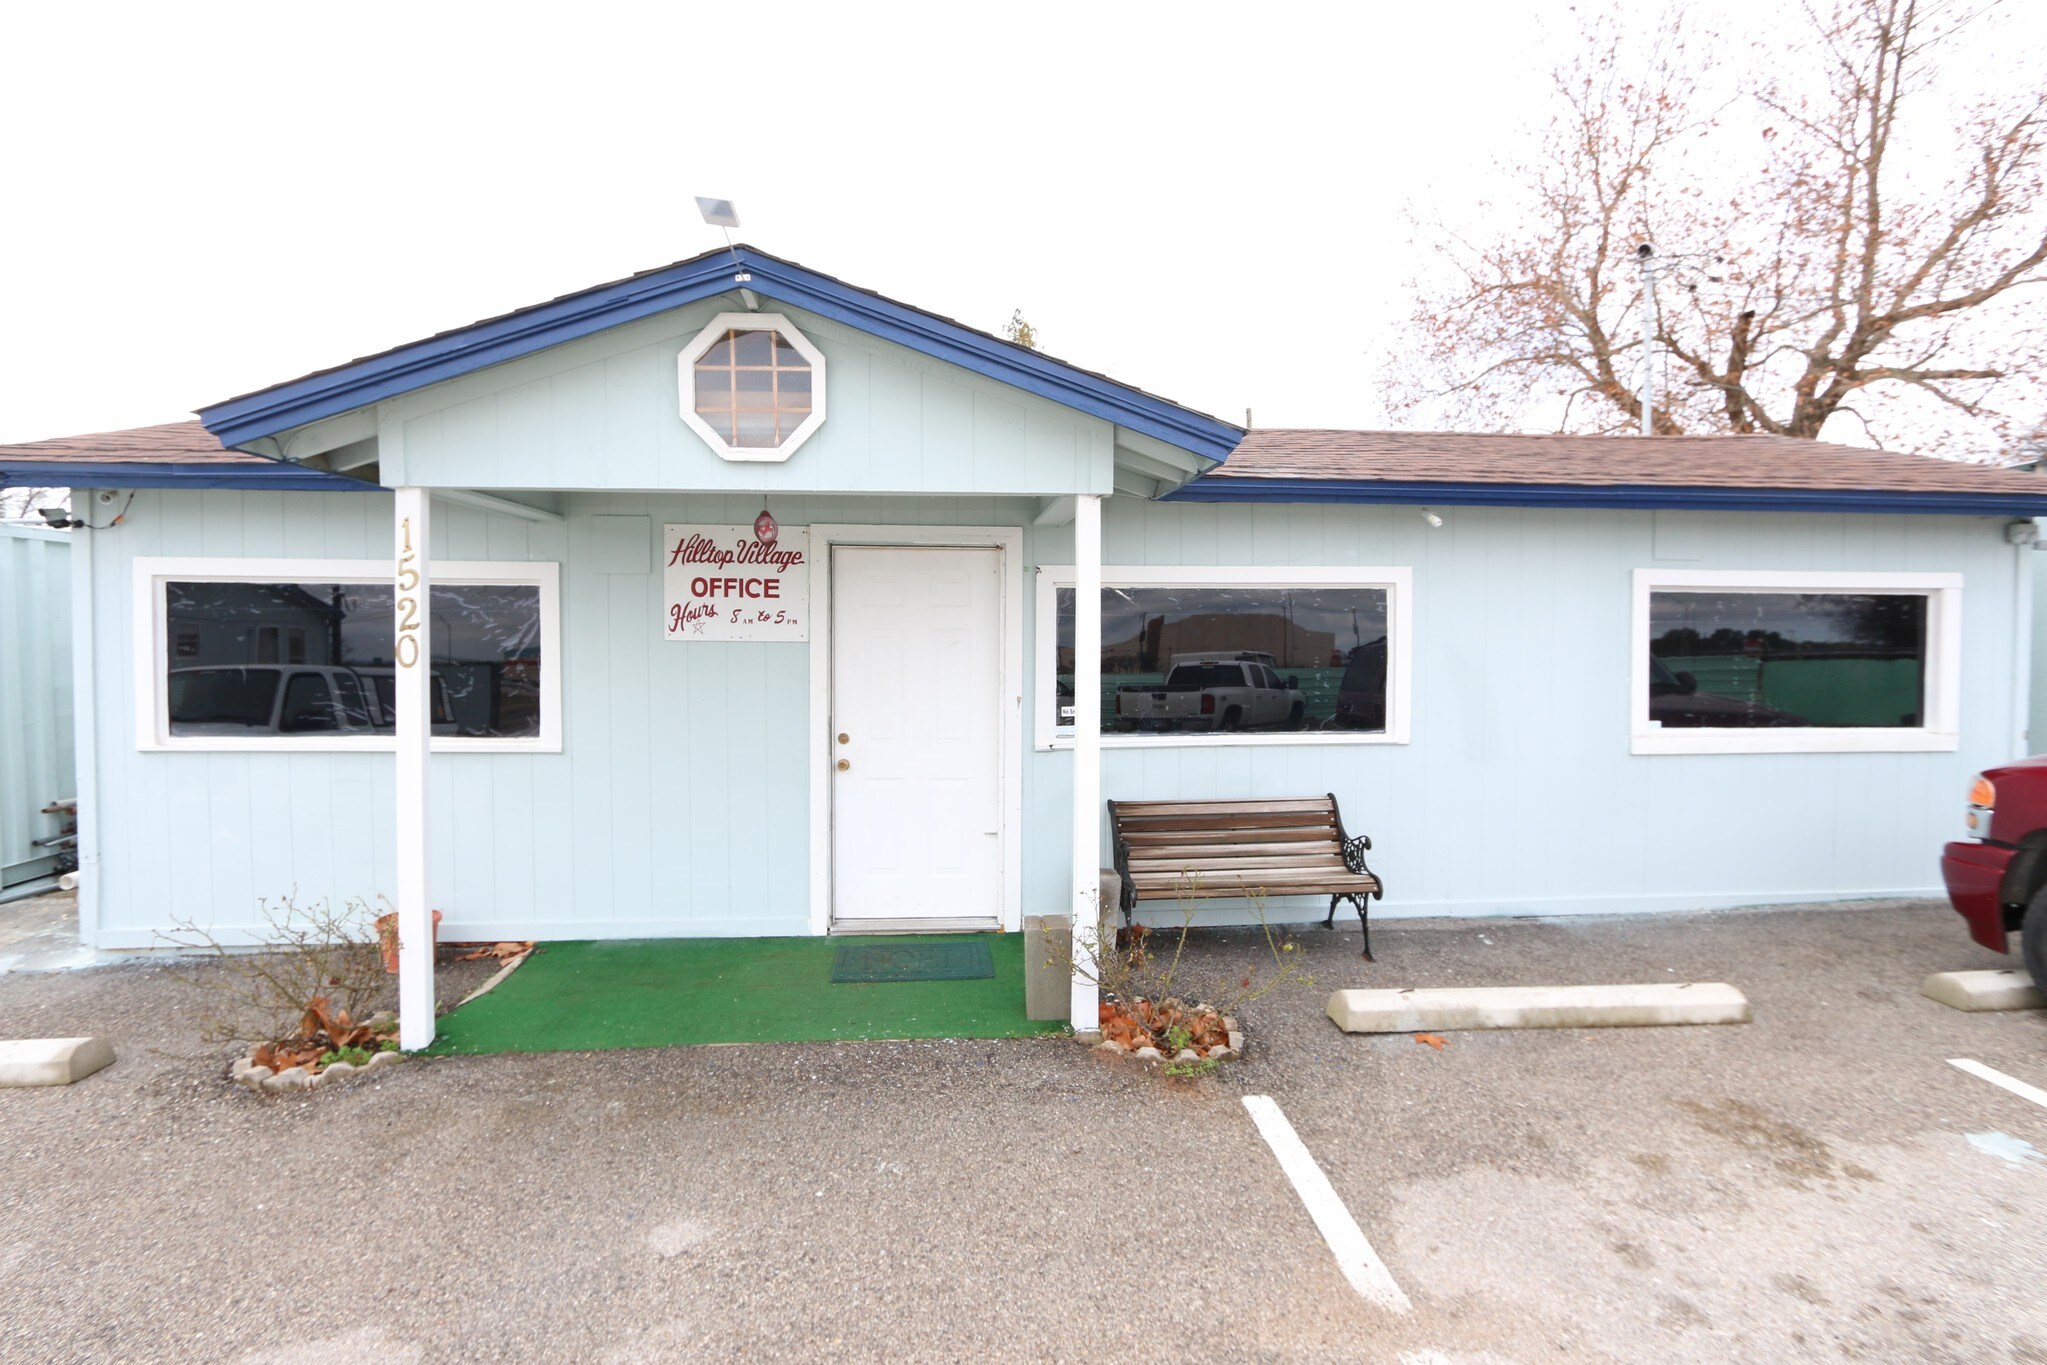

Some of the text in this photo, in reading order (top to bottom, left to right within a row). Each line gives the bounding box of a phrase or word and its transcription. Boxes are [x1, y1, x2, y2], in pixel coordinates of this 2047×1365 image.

[668, 534, 805, 573] Hilltop Village
[395, 516, 420, 668] 1520
[691, 577, 780, 599] OFFICE
[668, 601, 718, 632] Hours
[757, 610, 772, 622] to
[774, 610, 786, 624] 5
